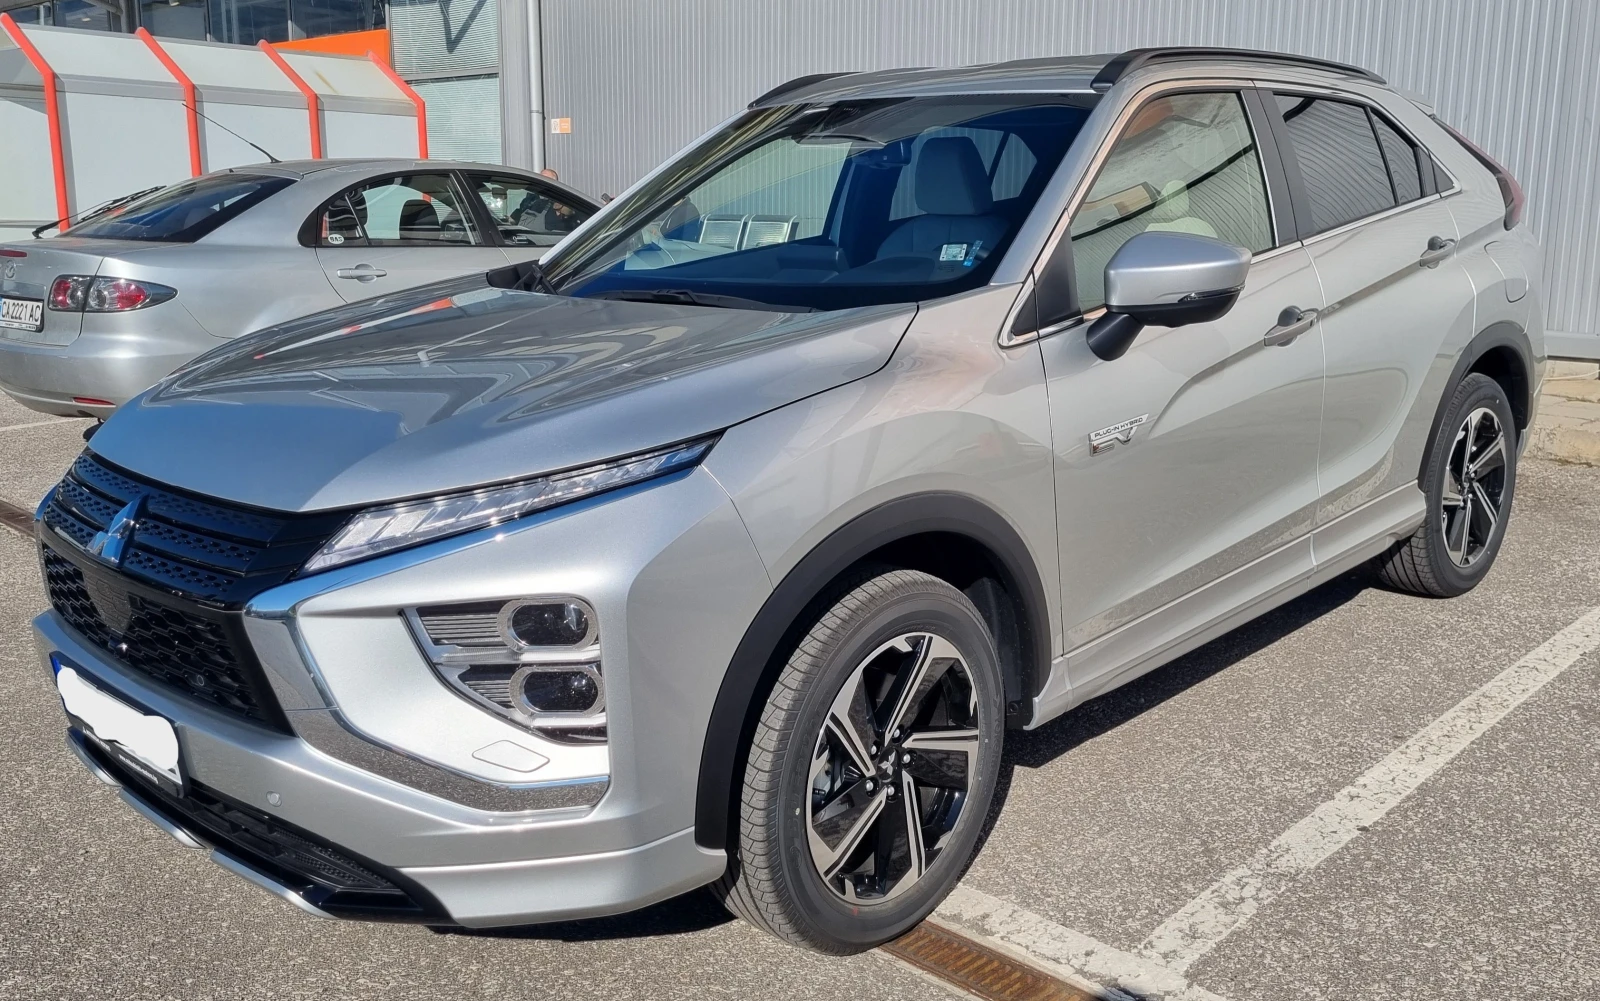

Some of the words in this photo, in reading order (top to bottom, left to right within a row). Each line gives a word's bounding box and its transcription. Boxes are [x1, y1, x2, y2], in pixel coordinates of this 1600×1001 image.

[10, 302, 28, 321] 2221
[29, 304, 41, 322] AC
[1094, 425, 1120, 438] PLUG-IN
[1119, 417, 1144, 429] HYBRID
